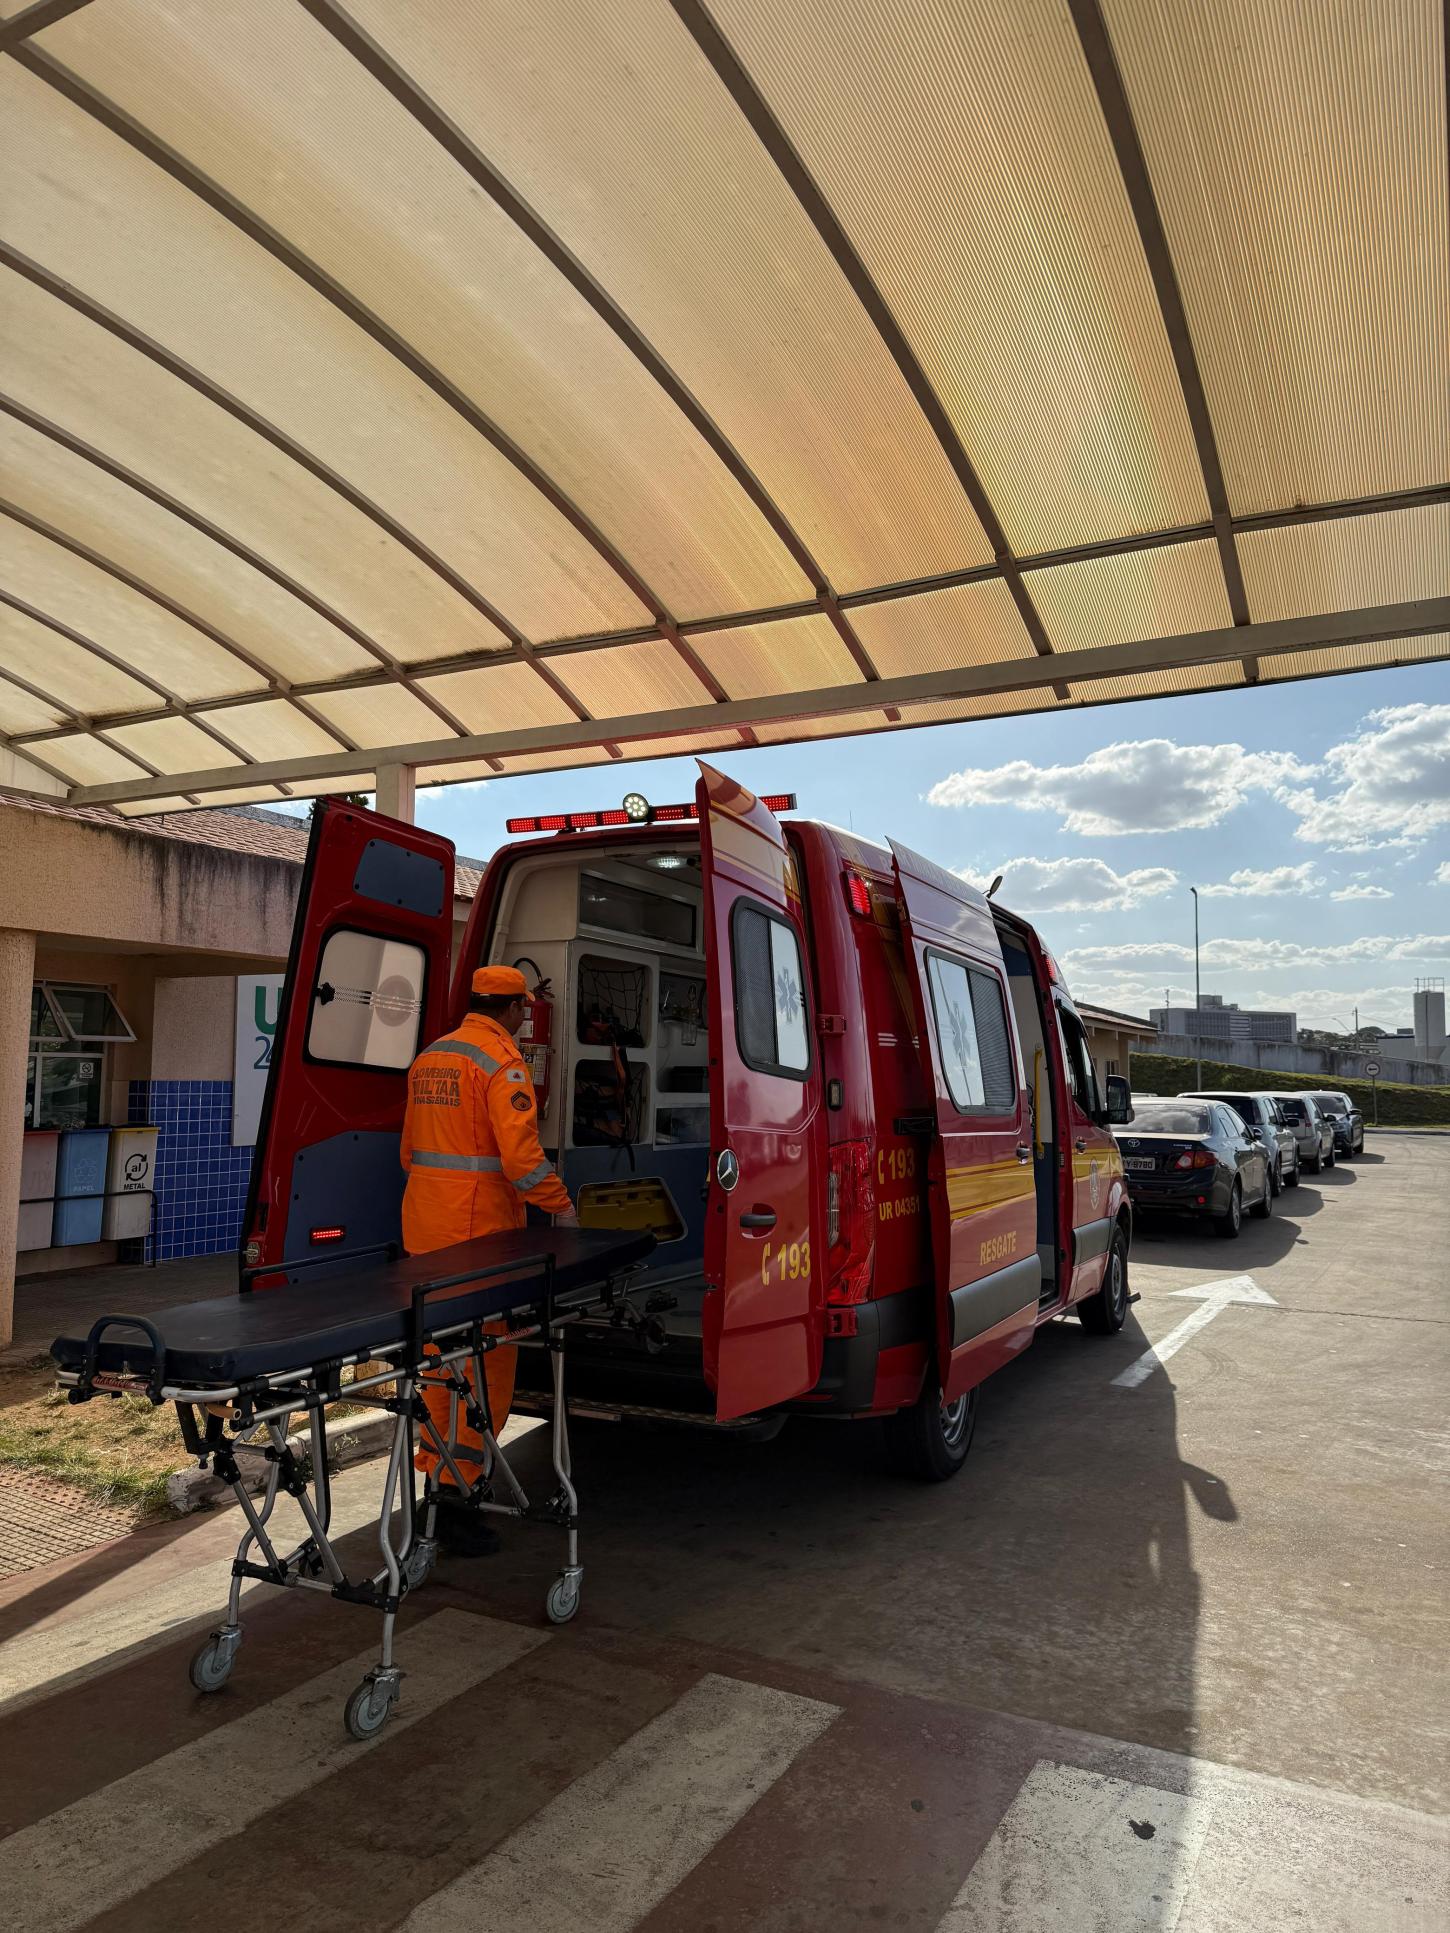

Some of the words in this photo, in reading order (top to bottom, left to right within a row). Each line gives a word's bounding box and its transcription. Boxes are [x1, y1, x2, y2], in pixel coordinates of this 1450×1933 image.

[413, 1067, 461, 1080] BOMBEIRO
[413, 1080, 460, 1097] MILTAR
[131, 1163, 142, 1173] al
[888, 1147, 915, 1180] 193
[124, 1183, 146, 1191] METAL
[879, 1201, 893, 1221] UR
[980, 1230, 1017, 1266] RESGATE
[777, 1242, 811, 1281] 193
